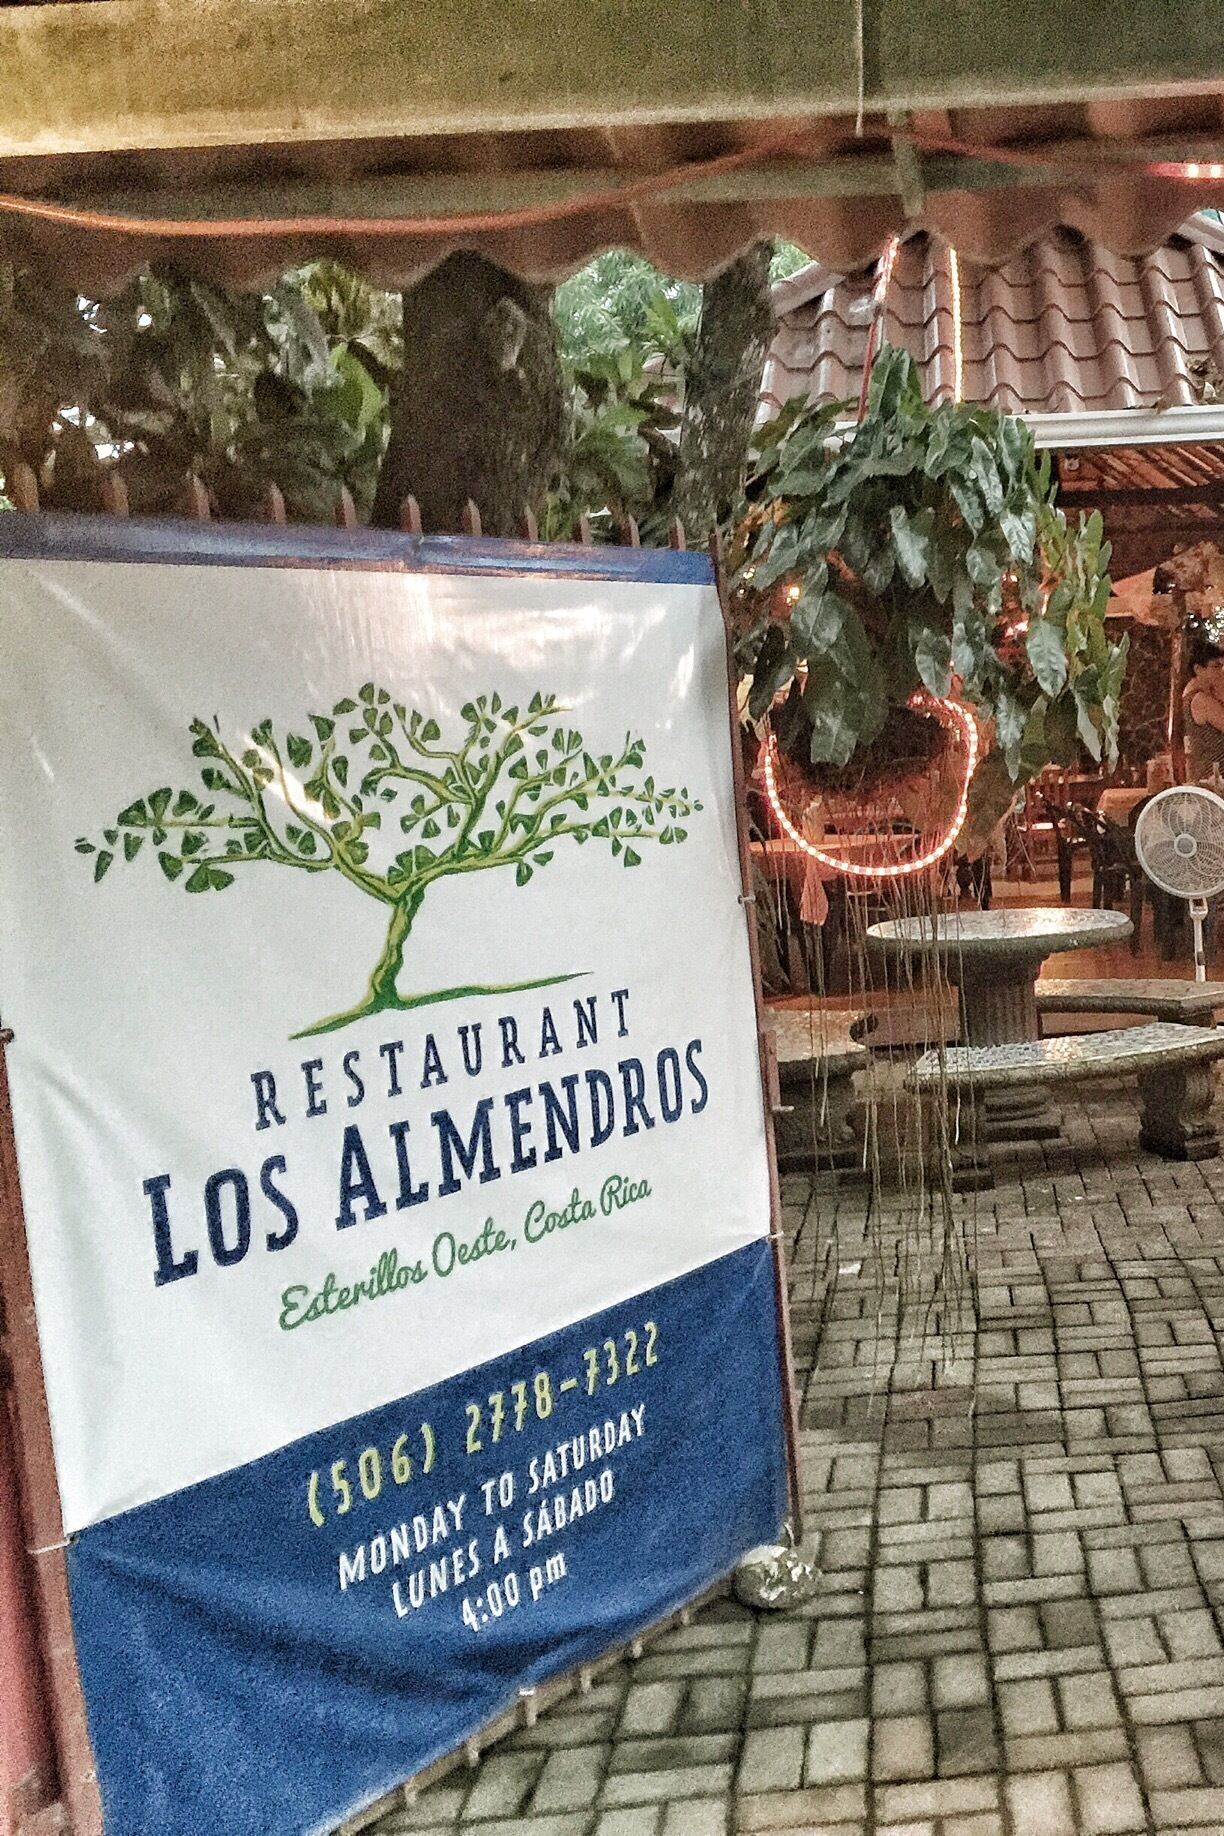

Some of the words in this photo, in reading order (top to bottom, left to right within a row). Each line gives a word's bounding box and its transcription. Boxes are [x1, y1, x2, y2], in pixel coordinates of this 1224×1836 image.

[250, 988, 633, 1131] RESTAURANT
[143, 1154, 299, 1287] LOS
[335, 1038, 710, 1231] ALMENDROS
[279, 1250, 428, 1331] Esterillos
[432, 1229, 517, 1278] Oeste,
[523, 1199, 598, 1245] Costa
[600, 1173, 653, 1218] Rica
[307, 1423, 436, 1528] (506)
[465, 1321, 659, 1455] 2778-7322
[338, 1494, 468, 1592] MONDAY
[481, 1471, 514, 1516] TO
[528, 1403, 647, 1495] SATURDAY
[392, 1539, 480, 1619] LUNES
[493, 1526, 511, 1565] A
[522, 1469, 615, 1548] SÁBADO
[461, 1573, 521, 1632] 4:00
[530, 1551, 567, 1601] pm
